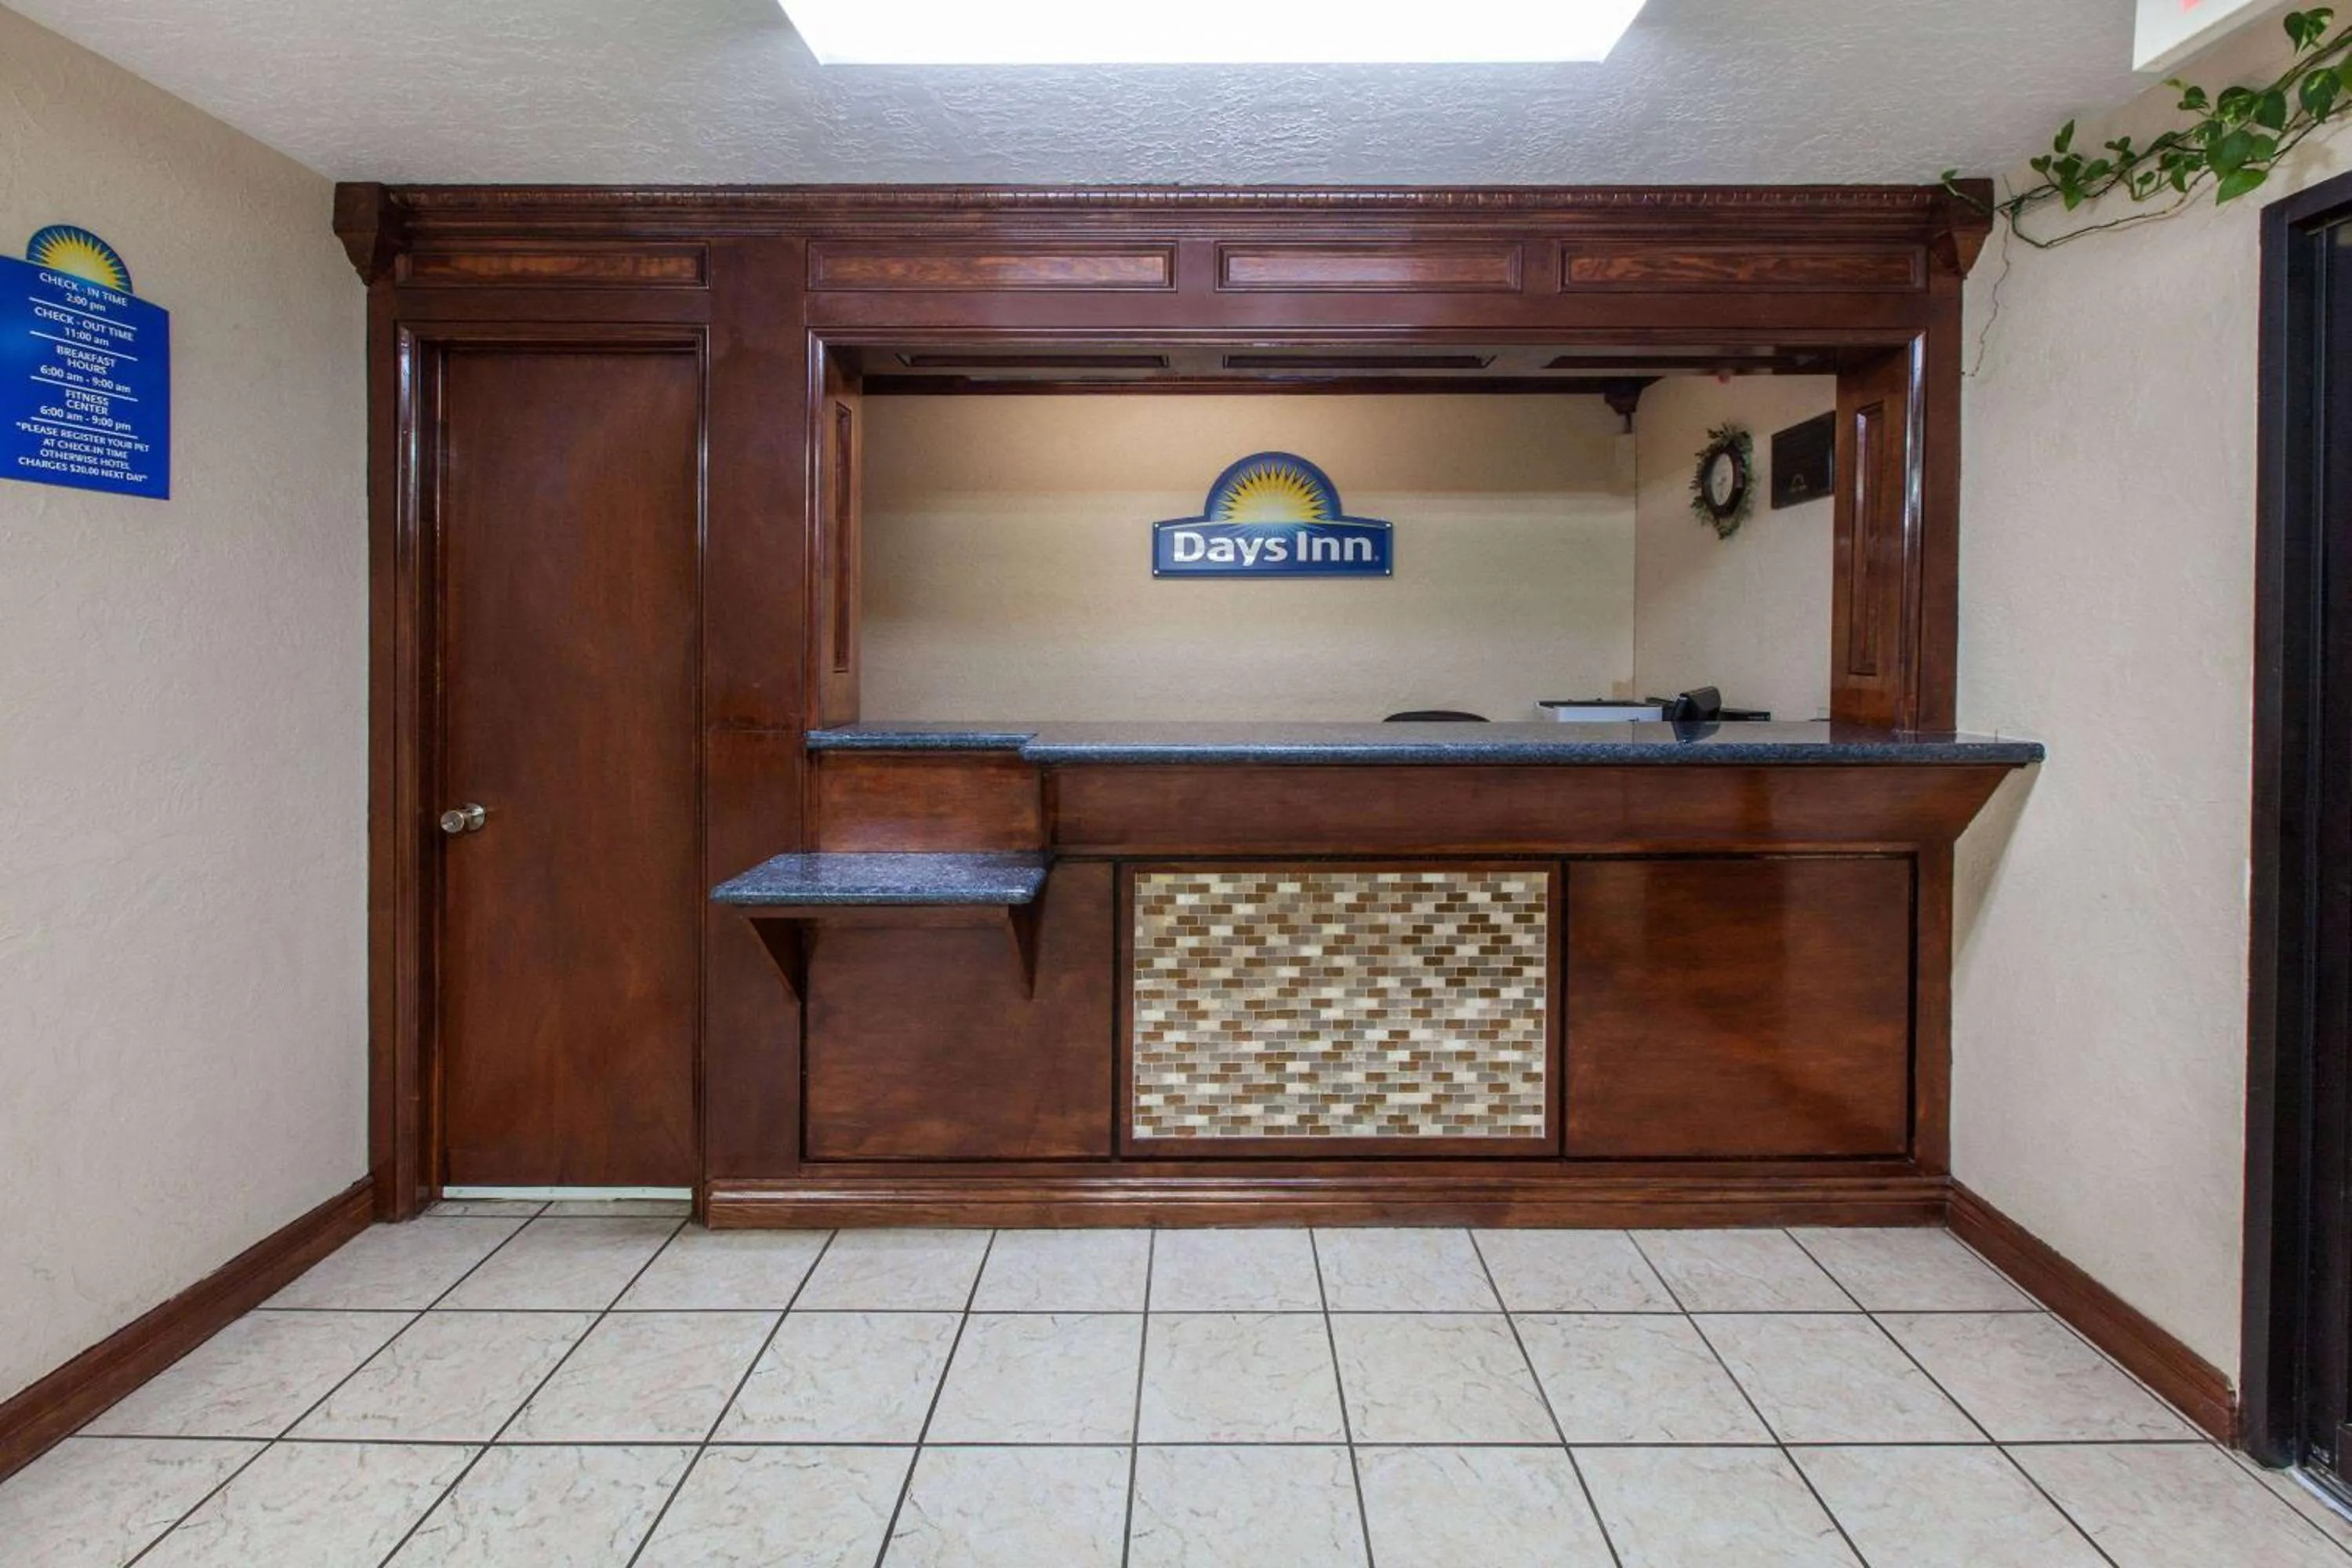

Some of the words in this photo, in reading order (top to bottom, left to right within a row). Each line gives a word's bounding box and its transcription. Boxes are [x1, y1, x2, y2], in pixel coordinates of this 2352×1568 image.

[39, 271, 78, 291] CHECK
[87, 287, 100, 298] IN
[102, 291, 128, 307] TIME
[66, 292, 88, 307] 2:00
[89, 302, 106, 311] pm
[34, 307, 74, 325] CHECK
[82, 320, 105, 333] OUT
[108, 327, 134, 342] TIME
[65, 328, 92, 342] 11:00
[93, 336, 109, 347] am
[56, 345, 115, 368] BREAKFAST
[67, 358, 107, 376] HOURS
[40, 365, 64, 378] 6:00
[67, 372, 84, 383] am
[92, 377, 114, 390] 9:00
[115, 383, 132, 394] am
[66, 389, 109, 406] FITNESS
[67, 399, 108, 416] CENTER
[40, 405, 64, 418] 6:00
[66, 412, 84, 422] am
[92, 416, 114, 427] 9:00
[115, 423, 132, 431] pm
[43, 437, 56, 448] AT
[106, 448, 129, 459] TIME
[60, 430, 106, 444] REGISTER
[108, 438, 132, 450] YOUR
[134, 443, 150, 452] PET
[18, 456, 68, 472] CHARGES
[100, 469, 124, 481] NEXT
[40, 448, 98, 465] OTHERWISE
[100, 458, 131, 470] HOTEL
[1173, 531, 1288, 567] Days
[1297, 531, 1372, 562] Inn
